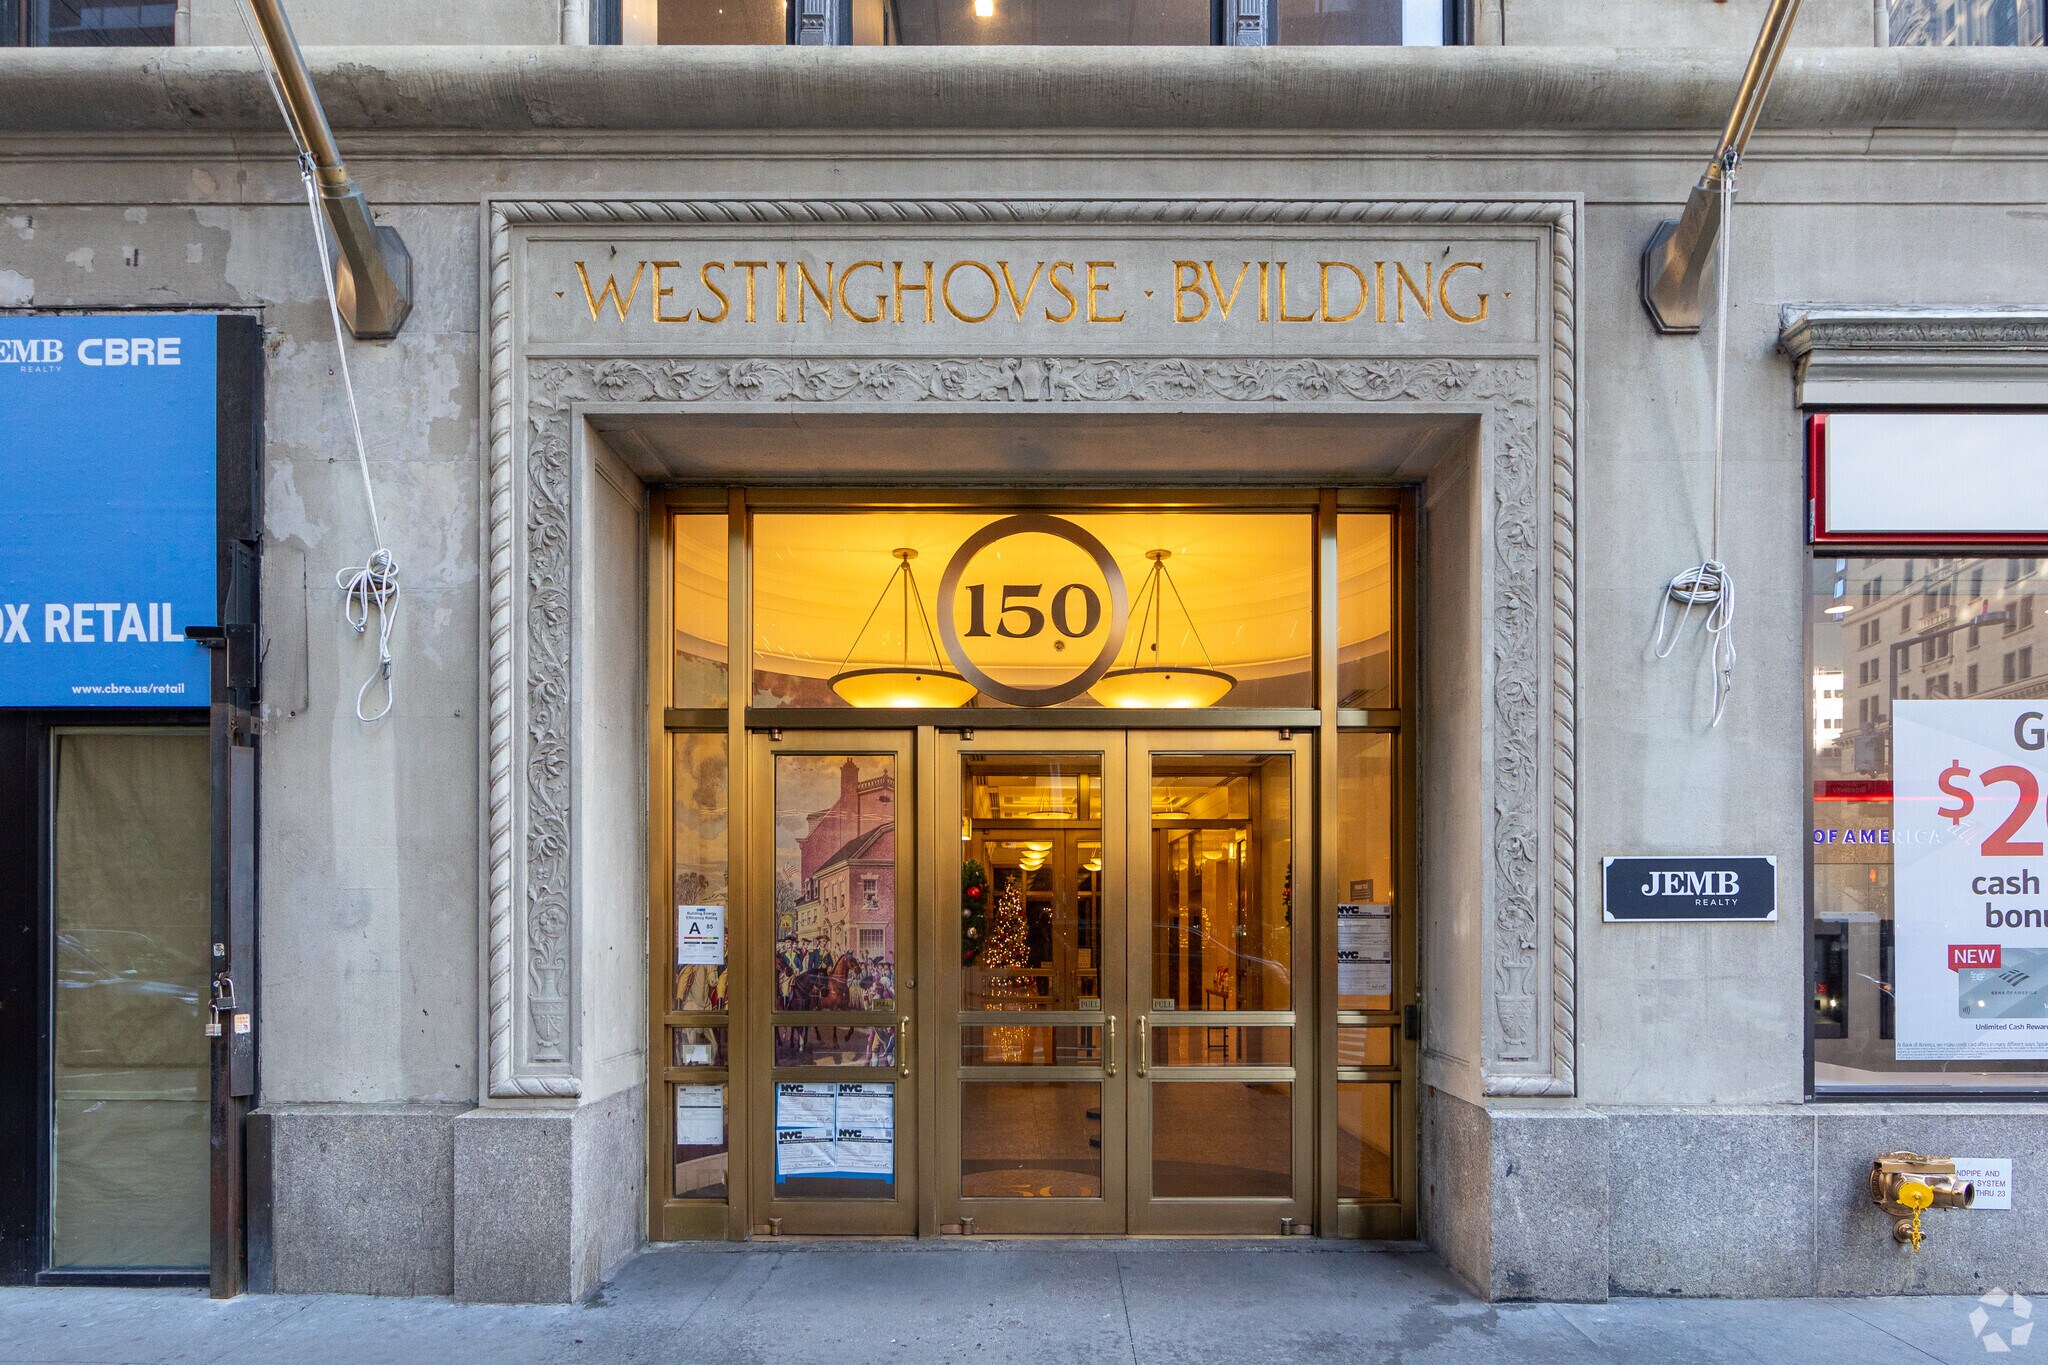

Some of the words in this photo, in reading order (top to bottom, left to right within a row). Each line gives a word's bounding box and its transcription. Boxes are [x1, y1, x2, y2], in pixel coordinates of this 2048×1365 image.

[575, 260, 1127, 323] WESTINGHOVSE
[1172, 260, 1490, 323] BVILDING
[77, 337, 181, 366] CBRE
[20, 365, 62, 373] REALTY
[964, 583, 1101, 638] 150
[0, 603, 31, 643] X
[45, 602, 185, 643] RETAIL
[72, 683, 185, 694] www.cbre.us/retail
[2014, 711, 2048, 751] G
[1937, 759, 2048, 857] $2
[1813, 829, 1838, 844] OF
[1641, 870, 1740, 897] JEMB
[1971, 868, 2040, 895] cash
[689, 922, 701, 935] A
[1954, 949, 1996, 964] NEW
[1975, 1023, 2007, 1031] Unlimited
[781, 1084, 804, 1092] NYC
[840, 1084, 863, 1092] NYC
[779, 1131, 802, 1139] NYC
[839, 1129, 862, 1137] NYC
[1976, 1189, 1995, 1197] THRU
